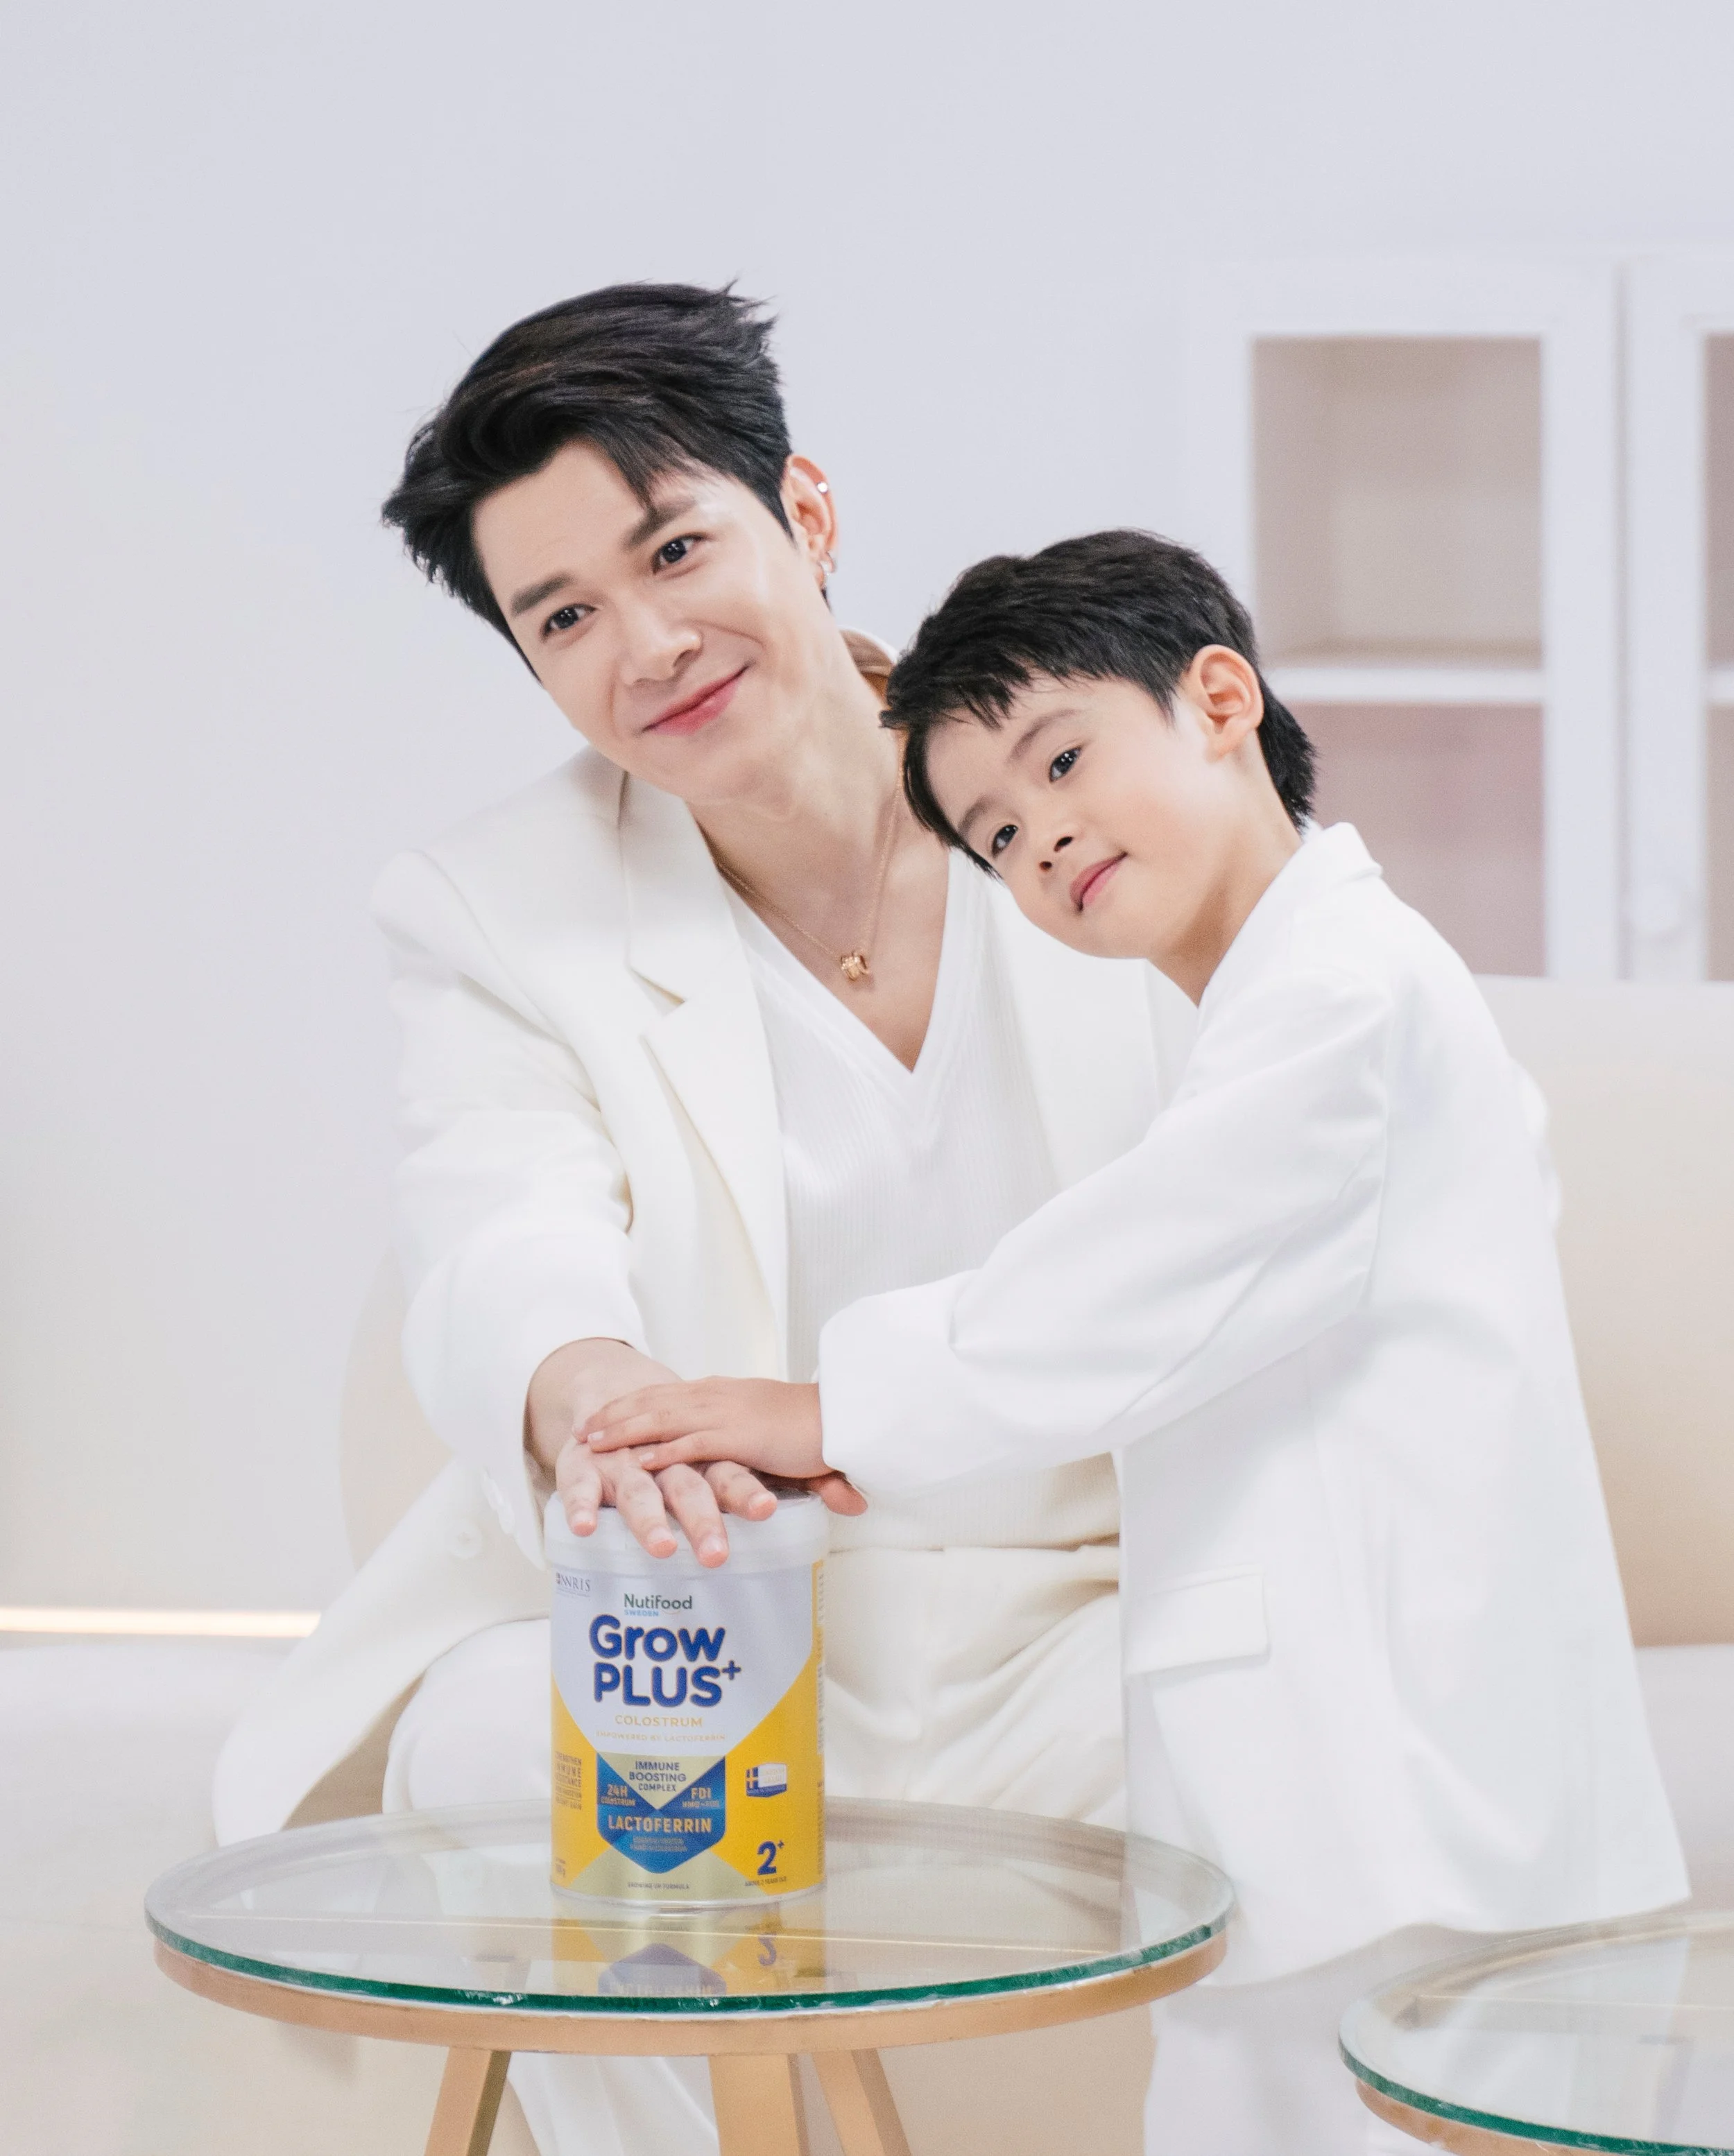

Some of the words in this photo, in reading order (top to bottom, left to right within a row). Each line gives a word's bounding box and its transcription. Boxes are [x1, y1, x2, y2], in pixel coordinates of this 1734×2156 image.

[624, 1593, 692, 1610] Nutifood
[590, 1614, 726, 1662] Grow
[615, 1714, 703, 1727] COLOSTRUM
[635, 1761, 680, 1770] IMMUNE
[629, 1772, 687, 1782] BOOSTING
[608, 1784, 628, 1797] 24H
[638, 1783, 677, 1792] COMPLEX
[608, 1815, 712, 1833] LACTOFERRIN
